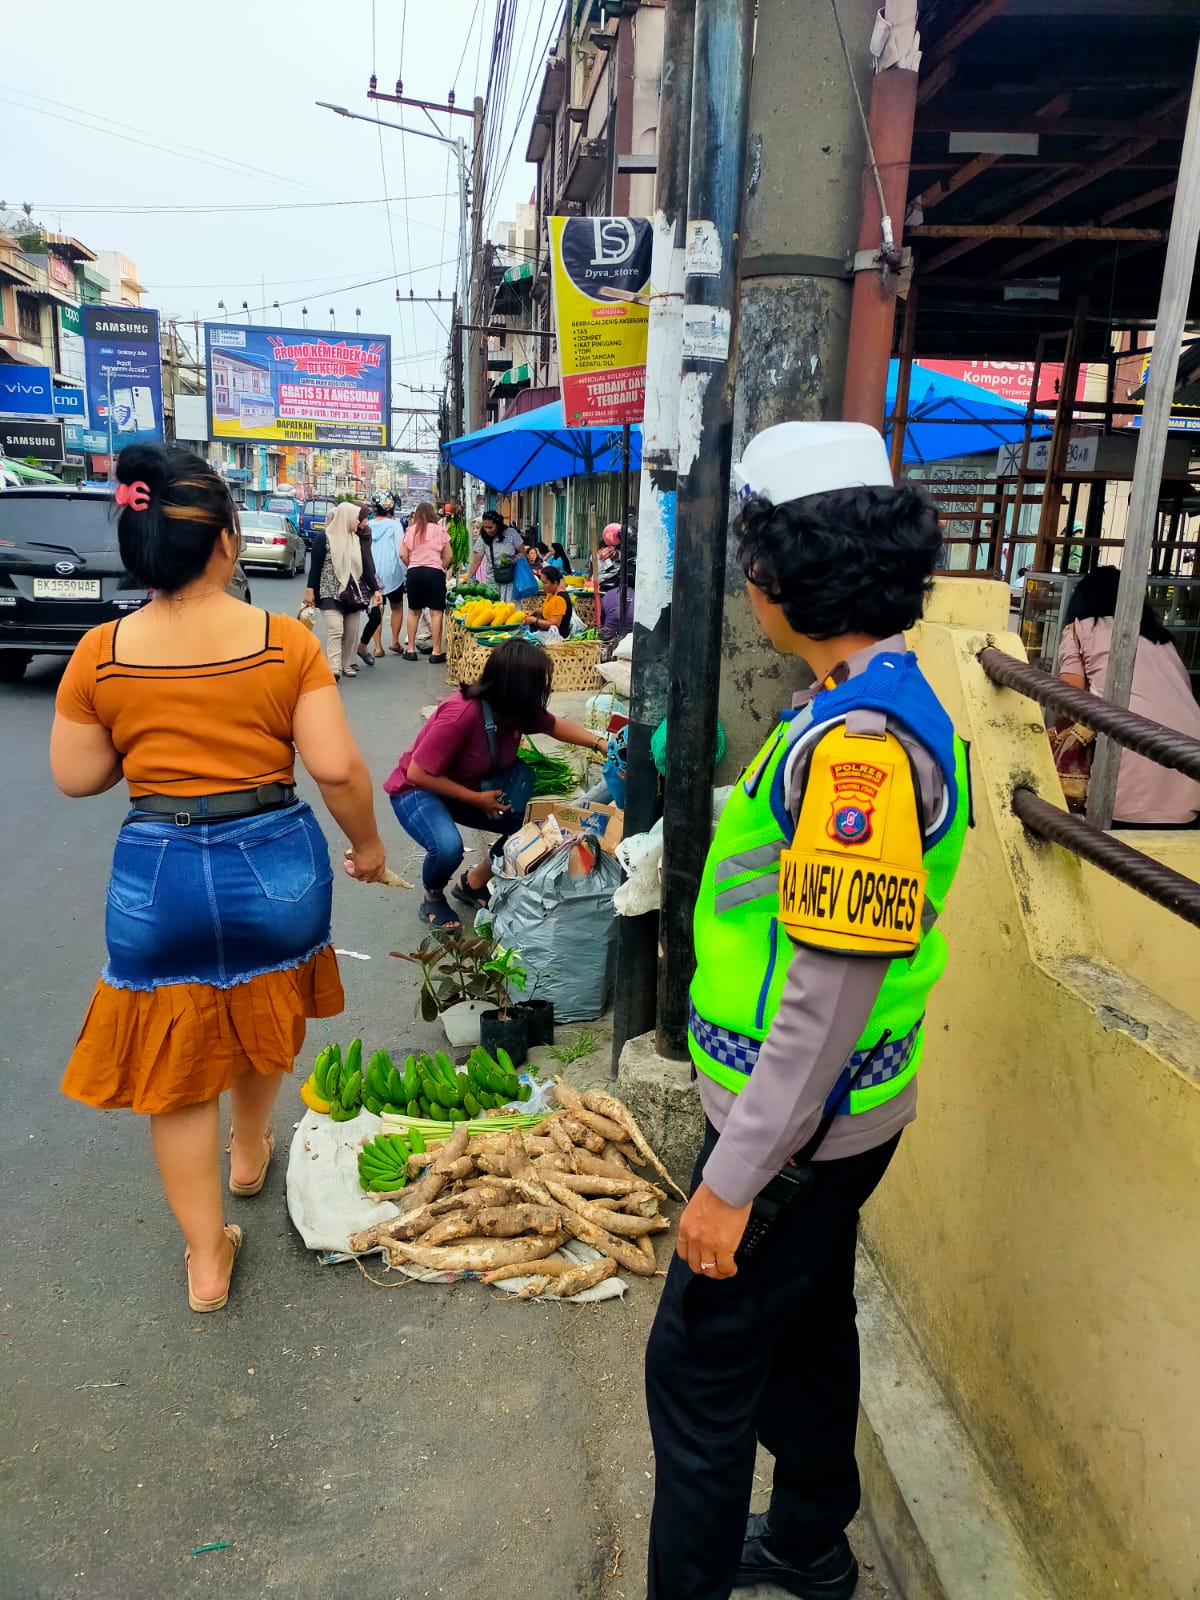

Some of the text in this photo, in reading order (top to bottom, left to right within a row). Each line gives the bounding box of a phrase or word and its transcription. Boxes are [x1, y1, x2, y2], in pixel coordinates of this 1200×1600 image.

[585, 268, 639, 279] Dyva_store
[95, 321, 149, 334] SAMSUNG
[274, 345, 380, 367] PROMO KEMERDEKAAN
[307, 362, 318, 374] RI
[963, 370, 1014, 386] Kompor
[5, 382, 44, 394] vivo
[281, 385, 379, 403] GRATIS 5 X ANGSURAN
[587, 380, 627, 396] TERBAIK
[596, 390, 638, 407] TERBARU
[276, 420, 313, 430] DAPATKAN
[6, 435, 56, 446] SAMSUNG
[285, 430, 301, 439] HARI
[303, 431, 312, 440] INI
[37, 580, 50, 590] BK
[51, 580, 77, 591] 1559
[835, 764, 883, 780] POLRES
[782, 860, 918, 932] KA ANEV OPSRES
